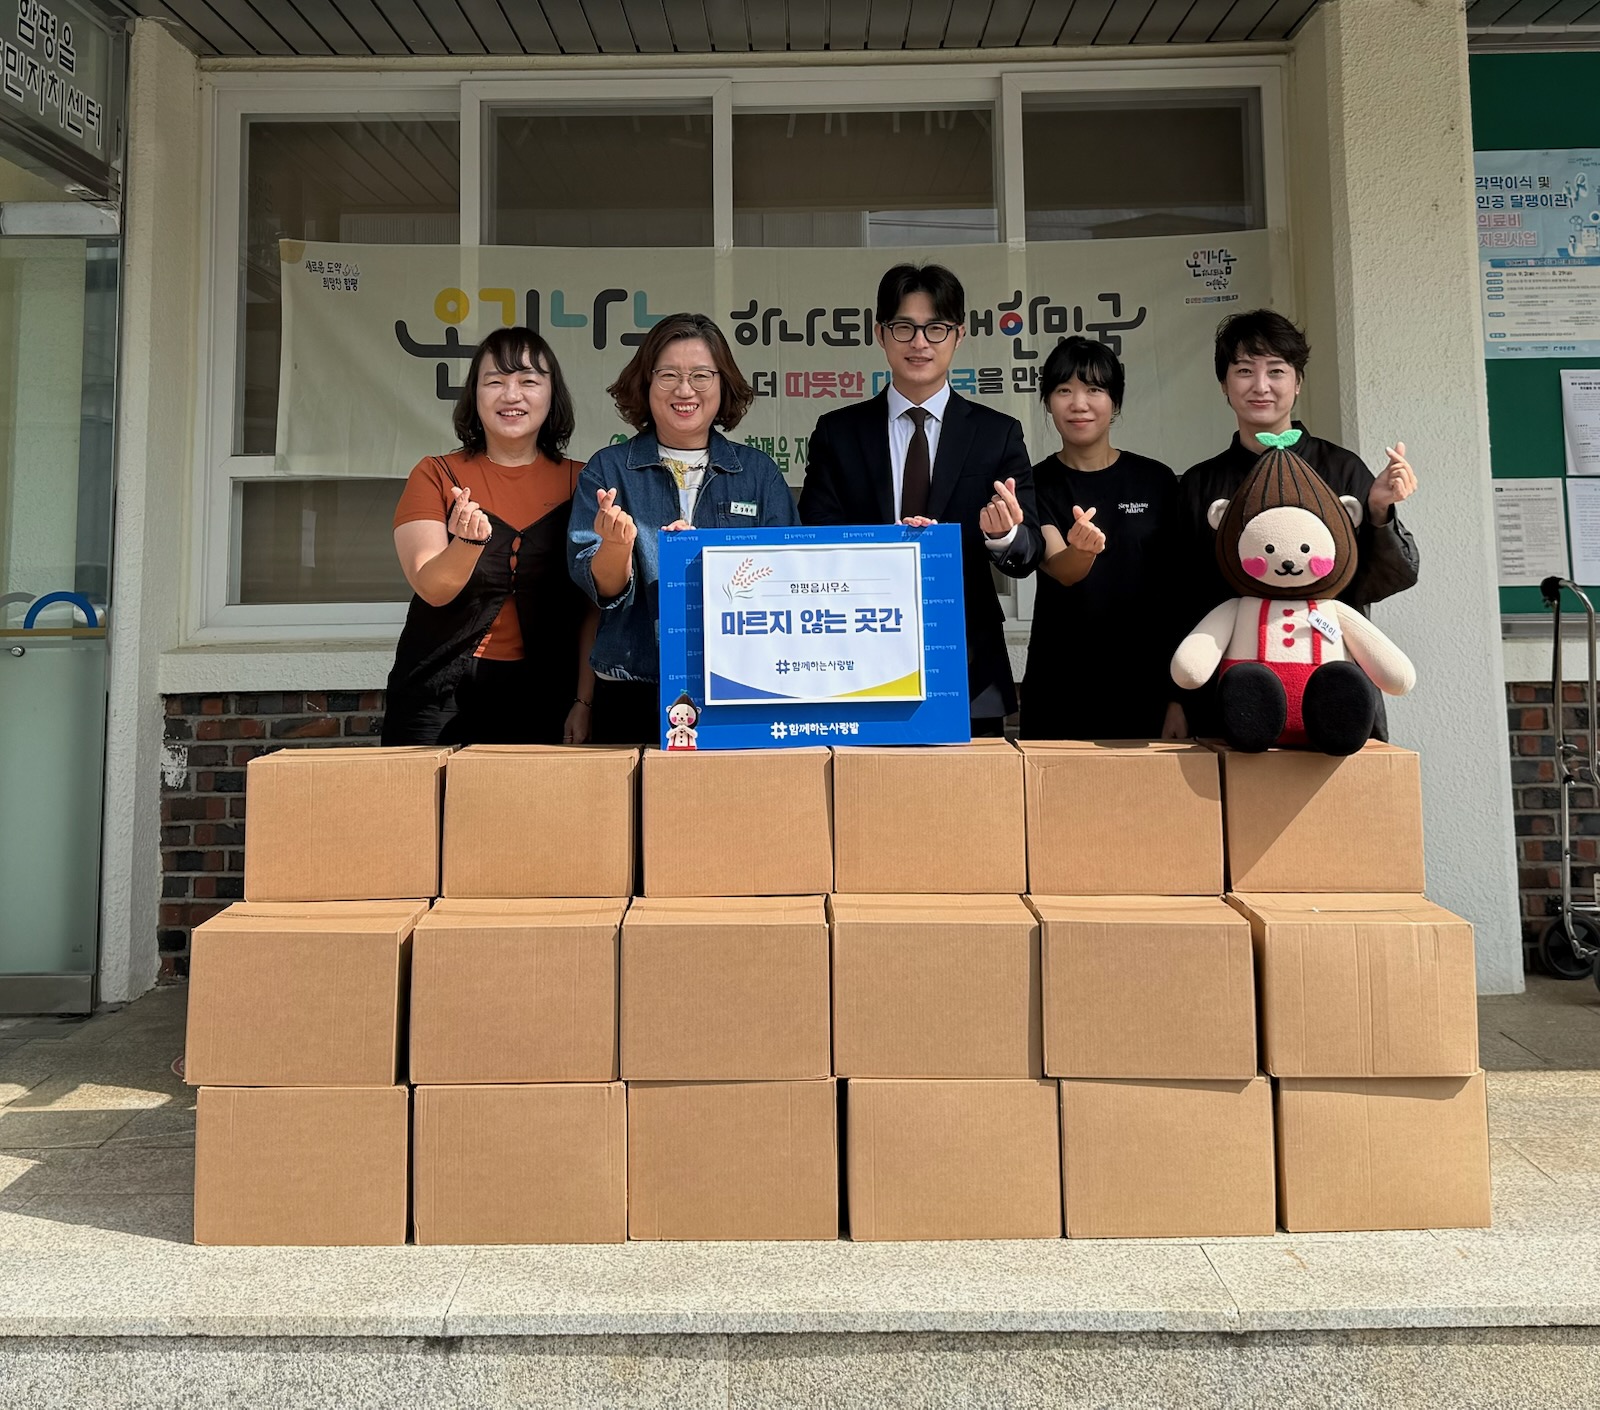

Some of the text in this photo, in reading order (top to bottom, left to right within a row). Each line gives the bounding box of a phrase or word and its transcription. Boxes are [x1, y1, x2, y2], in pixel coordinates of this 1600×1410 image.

[17, 0, 77, 76] 함평읍
[0, 39, 103, 150] 민자치센터
[1475, 176, 1550, 190] 각막이식 및
[1477, 193, 1568, 209] 인공 달팽이관
[1478, 213, 1521, 228] 의료비
[343, 278, 358, 291] 함평
[785, 371, 865, 398] 따뜻한
[790, 582, 850, 594] 함평읍사무소
[721, 608, 903, 635] 마르지 않는 곳간
[1315, 616, 1336, 636] 씨앗이
